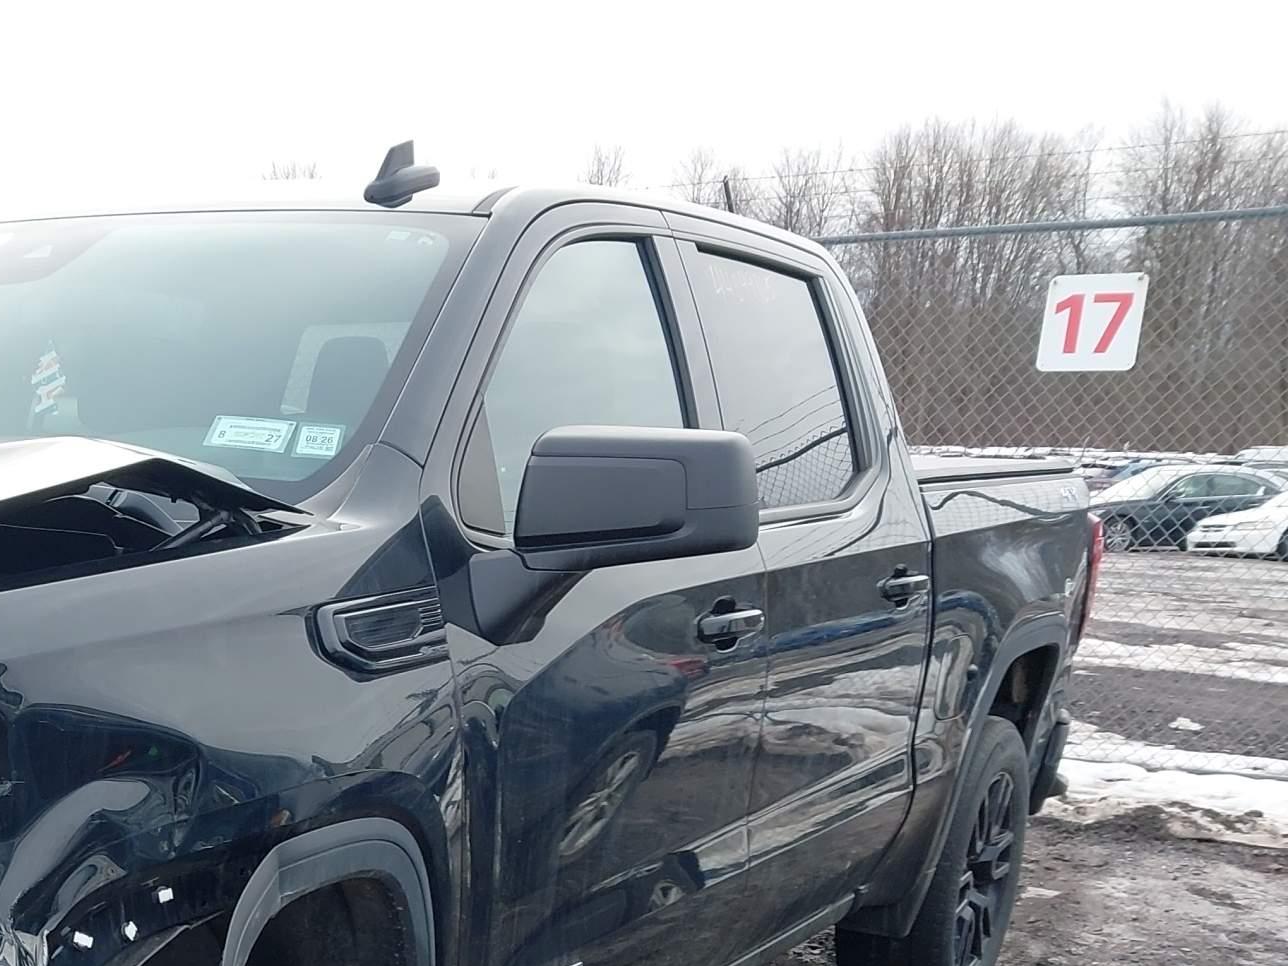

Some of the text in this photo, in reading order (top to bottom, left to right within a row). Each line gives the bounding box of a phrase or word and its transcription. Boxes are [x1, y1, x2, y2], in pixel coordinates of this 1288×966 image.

[1055, 293, 1134, 354] 17
[265, 434, 282, 443] 27
[321, 435, 334, 444] 26
